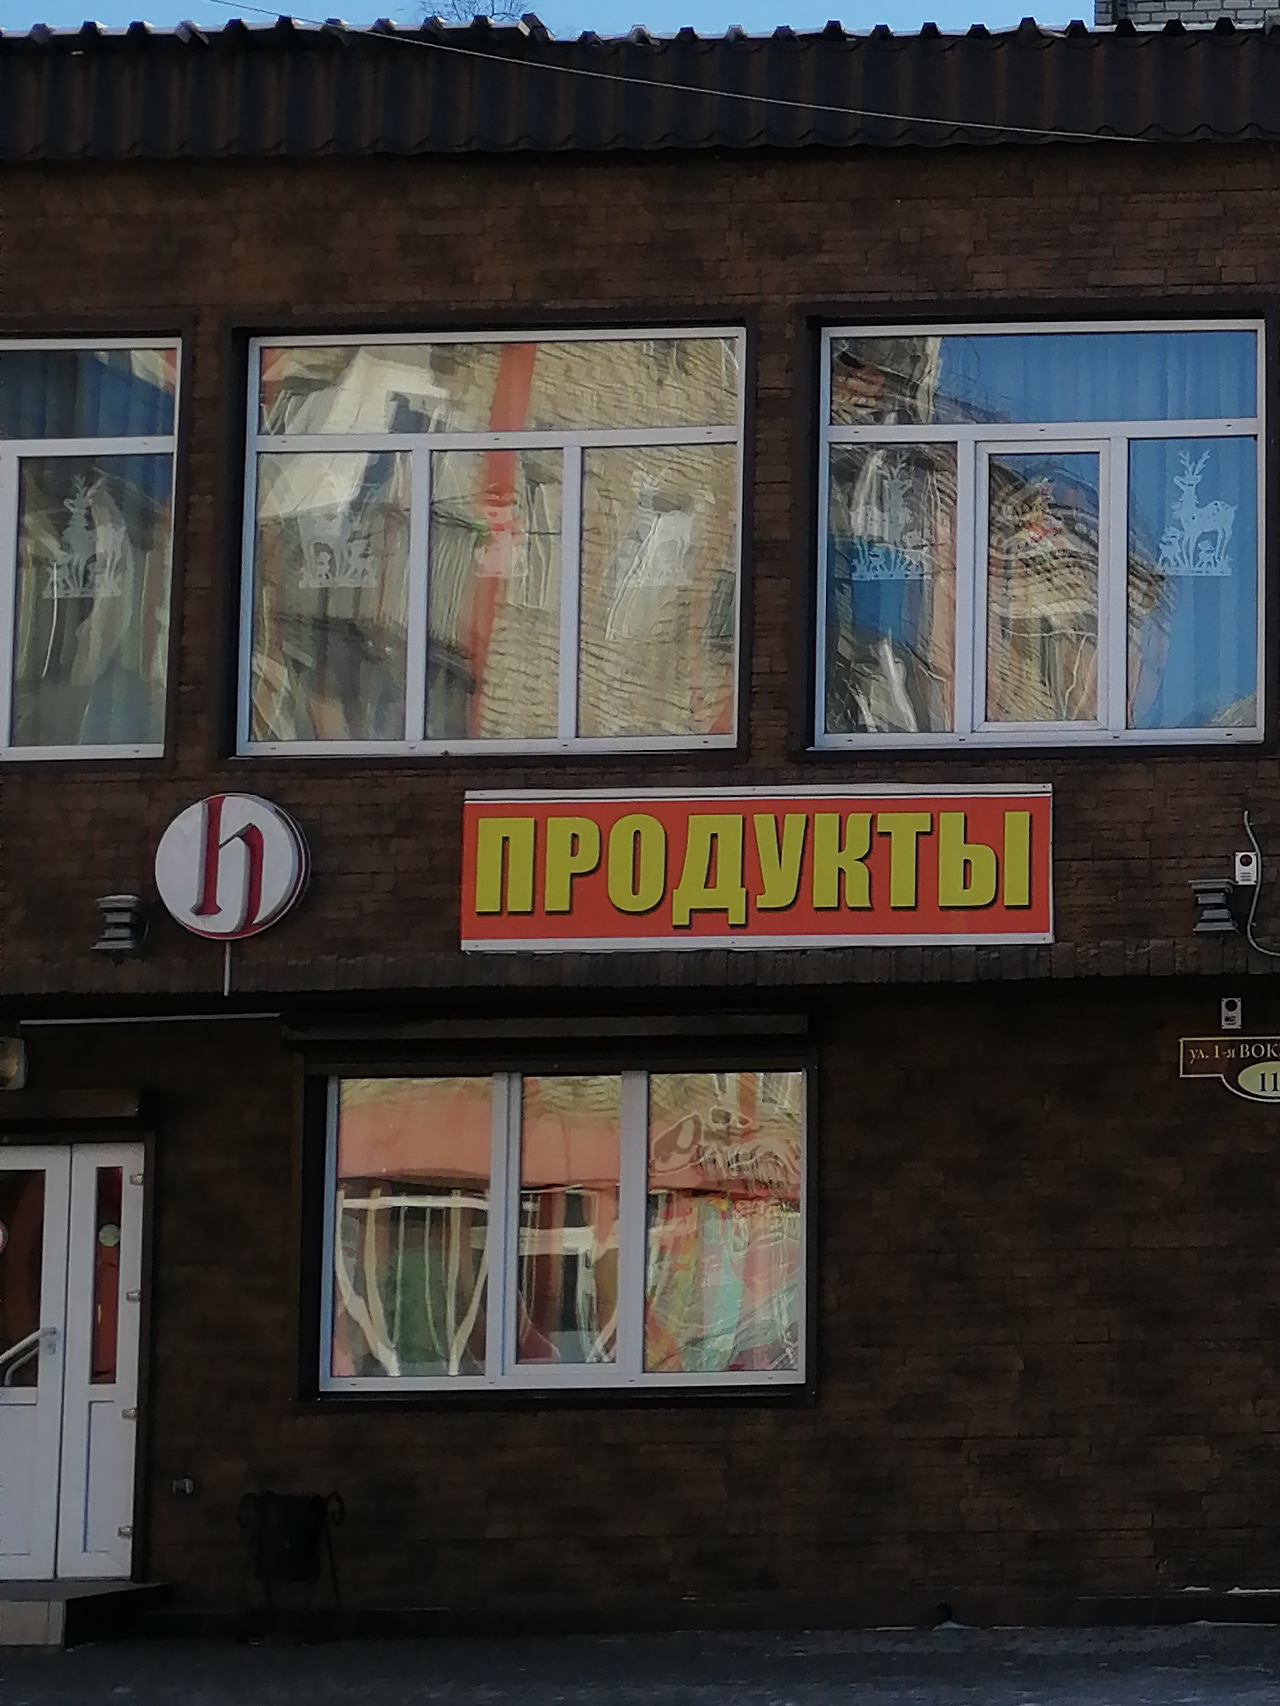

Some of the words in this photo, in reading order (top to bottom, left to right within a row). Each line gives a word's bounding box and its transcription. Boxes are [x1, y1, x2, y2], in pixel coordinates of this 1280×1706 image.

[474, 811, 1032, 929] ПРОДУКТЫ
[1189, 1047, 1210, 1064] ул.
[1213, 1044, 1236, 1059] 1-я
